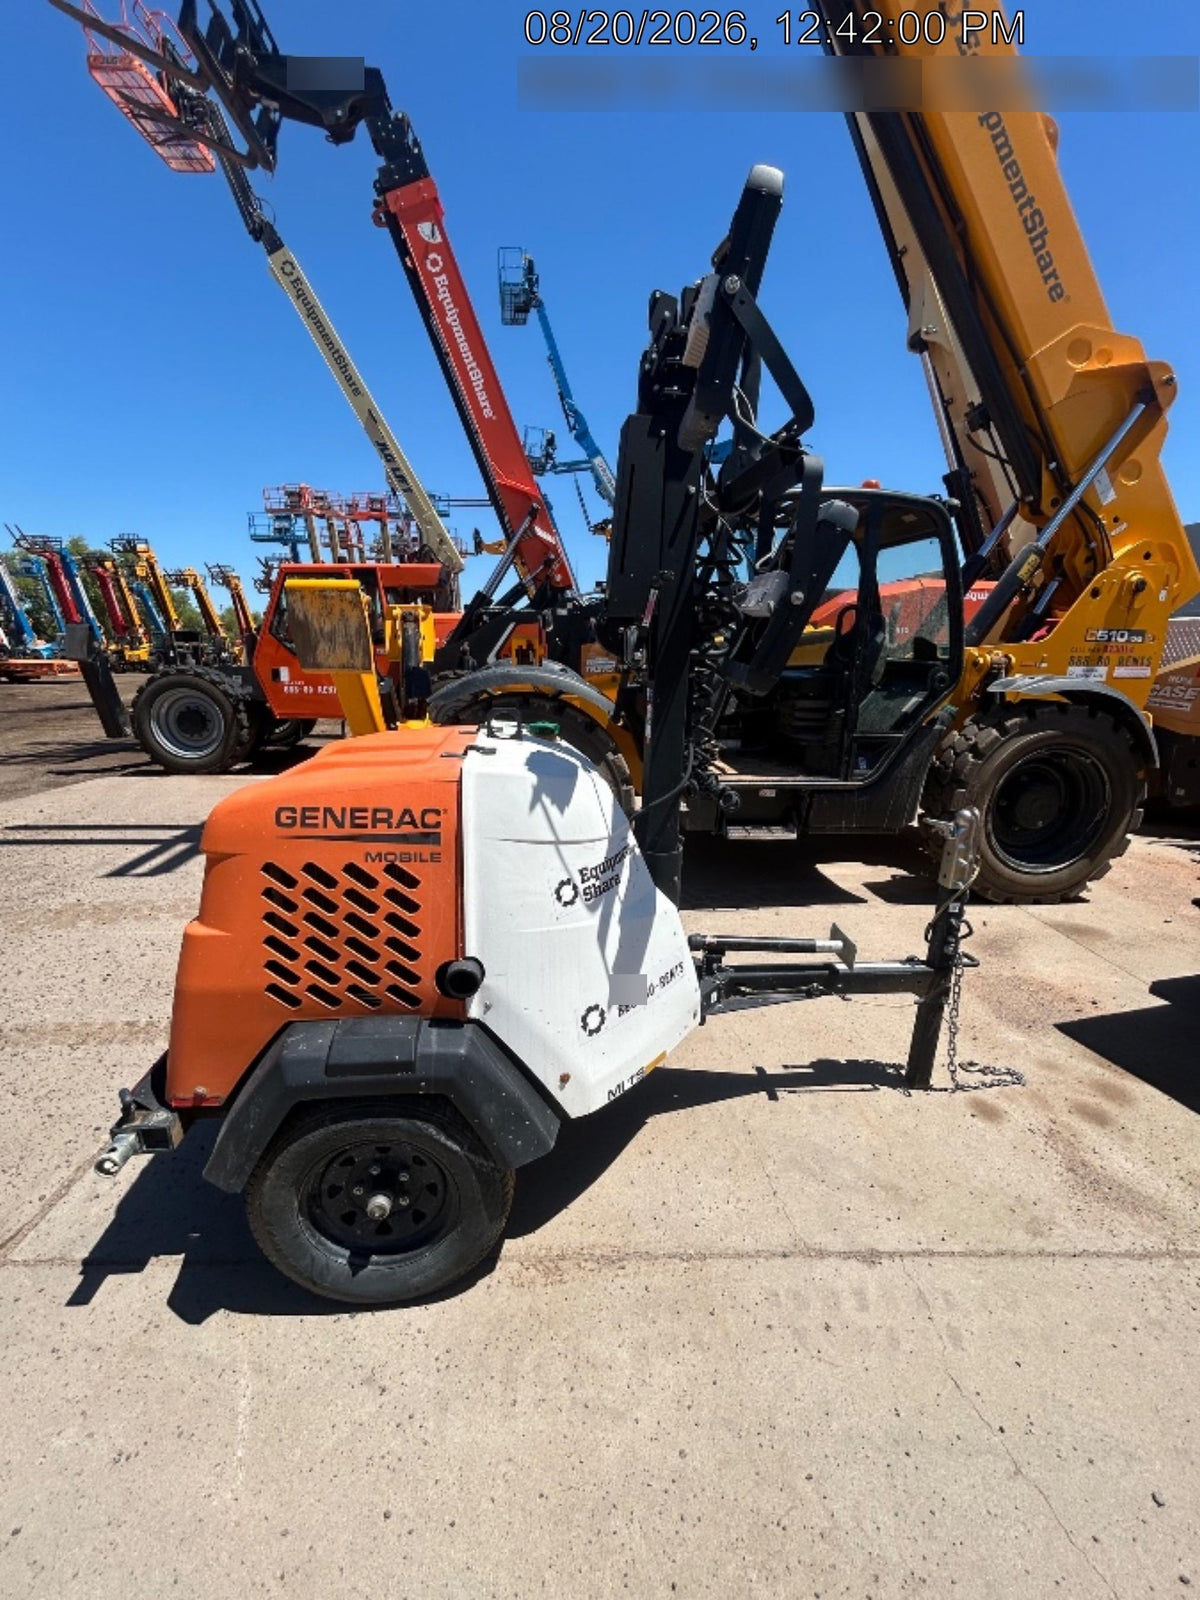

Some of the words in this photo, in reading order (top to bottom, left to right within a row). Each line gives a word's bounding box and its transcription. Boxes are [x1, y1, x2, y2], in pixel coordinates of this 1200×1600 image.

[290, 275, 363, 397] EquipmentShare
[433, 273, 494, 419] EquipmentShare
[275, 806, 442, 829] GENERAC
[364, 852, 442, 863] MOBILE
